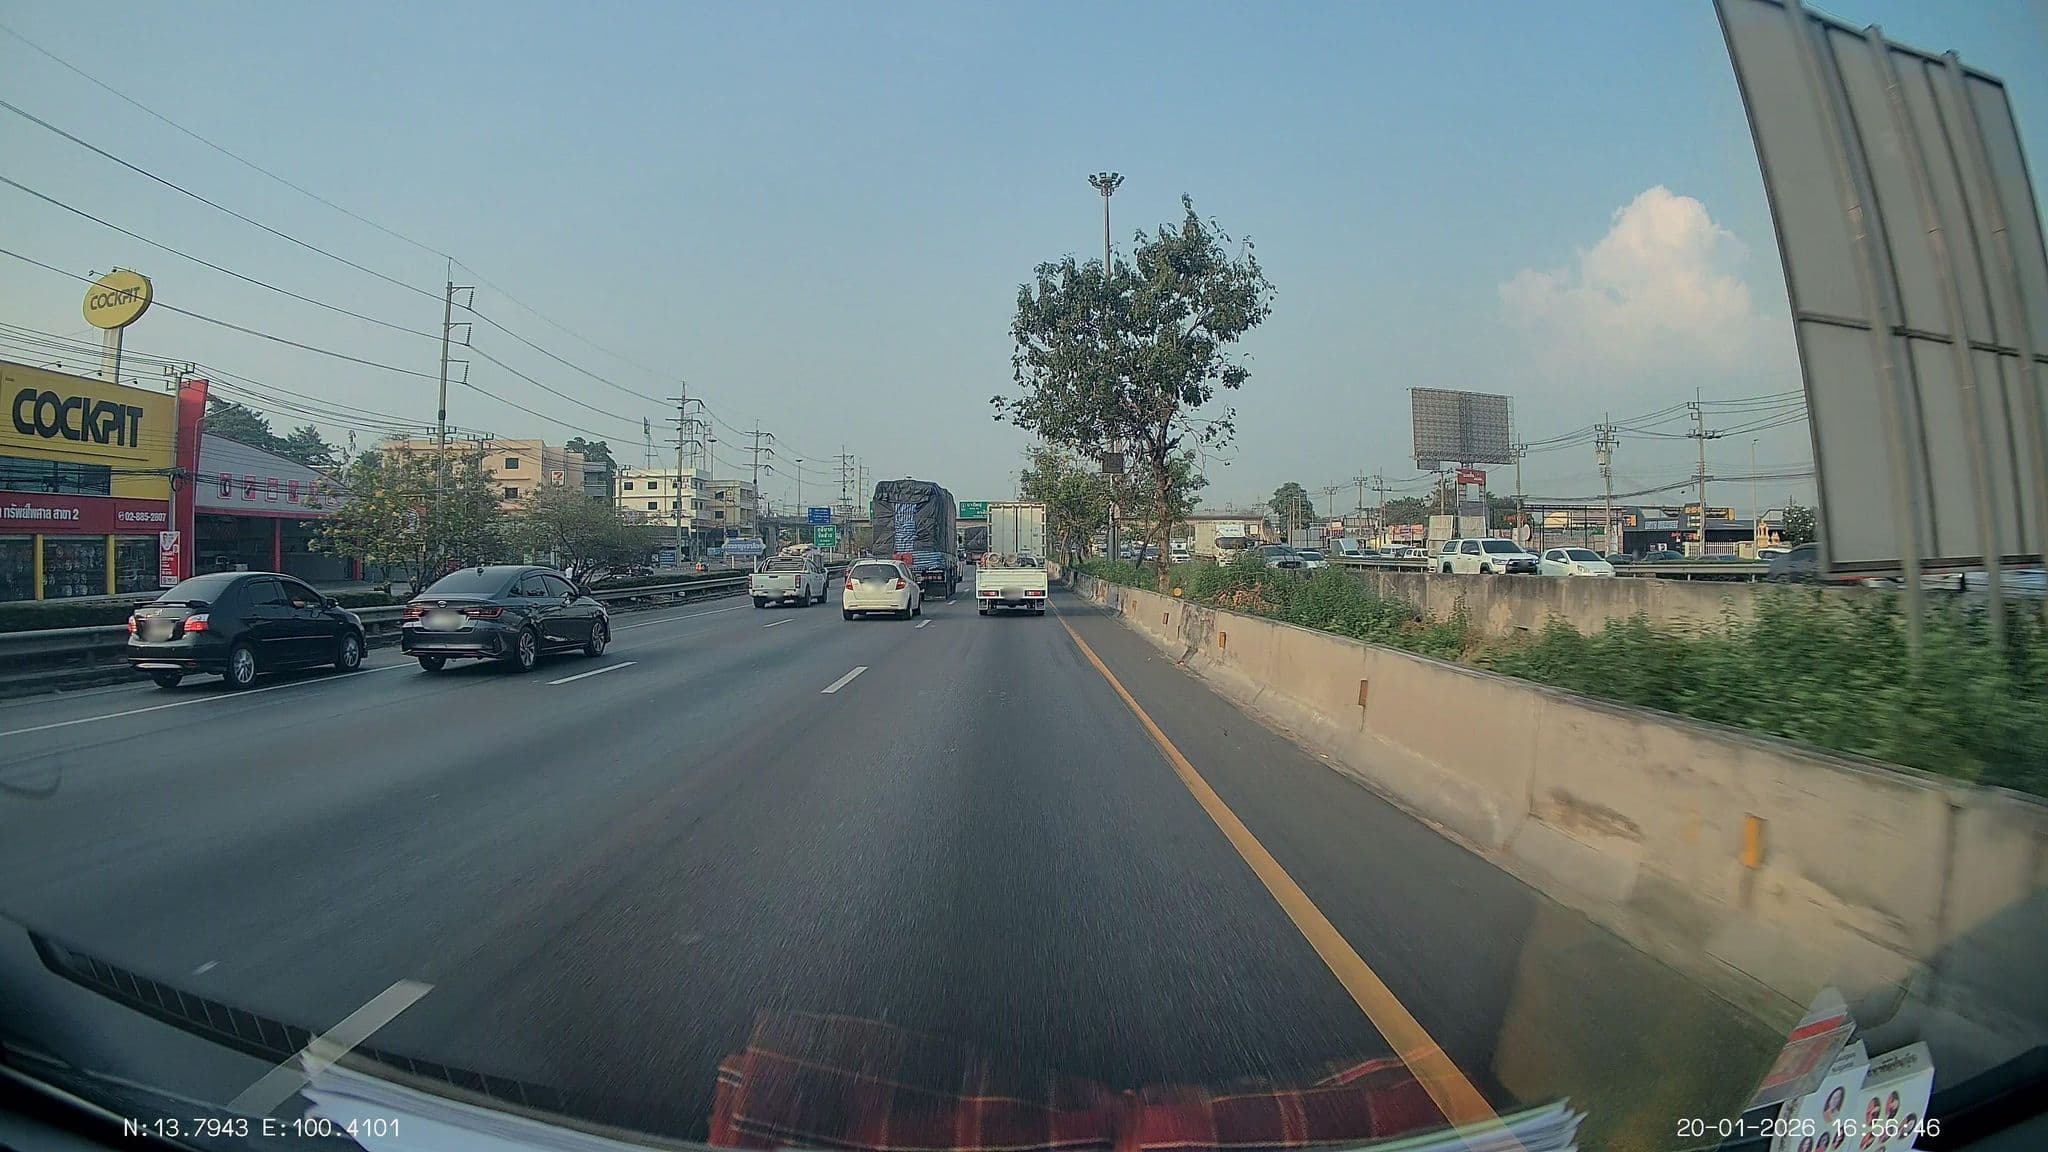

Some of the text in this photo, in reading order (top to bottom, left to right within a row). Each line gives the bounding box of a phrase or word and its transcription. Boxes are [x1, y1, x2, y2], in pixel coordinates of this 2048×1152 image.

[90, 286, 140, 310] COCKPIT
[12, 387, 143, 447] COCKPIT
[72, 508, 79, 520] 2
